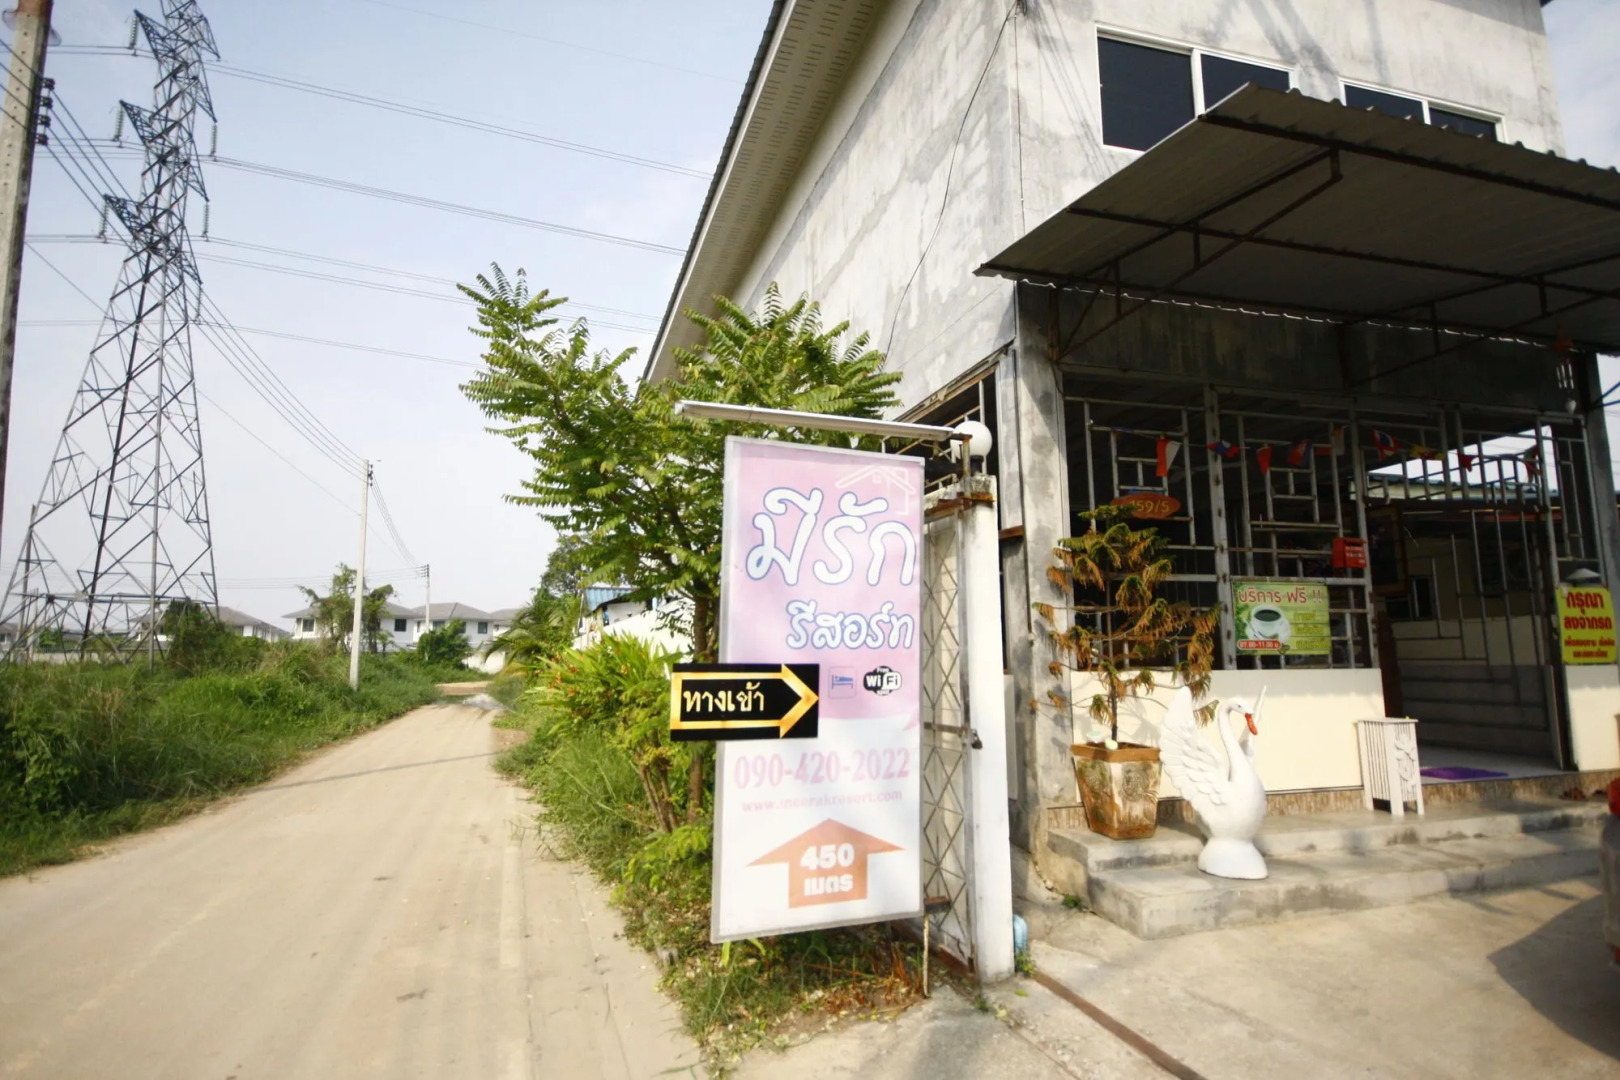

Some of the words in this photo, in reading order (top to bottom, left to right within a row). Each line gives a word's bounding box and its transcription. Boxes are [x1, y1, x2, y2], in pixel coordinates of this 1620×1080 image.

[745, 487, 917, 587] มีรัก
[1238, 586, 1282, 603] บริการ
[1286, 586, 1307, 604] ฟรี
[1566, 591, 1605, 615] กรุณา
[786, 599, 915, 650] รีสอร์ท
[1563, 616, 1613, 630] ลงจากรถ
[682, 681, 765, 713] ทางเข้า
[734, 746, 911, 790] 090-420-2022
[799, 842, 855, 871] 450
[803, 873, 854, 897] เมตร
